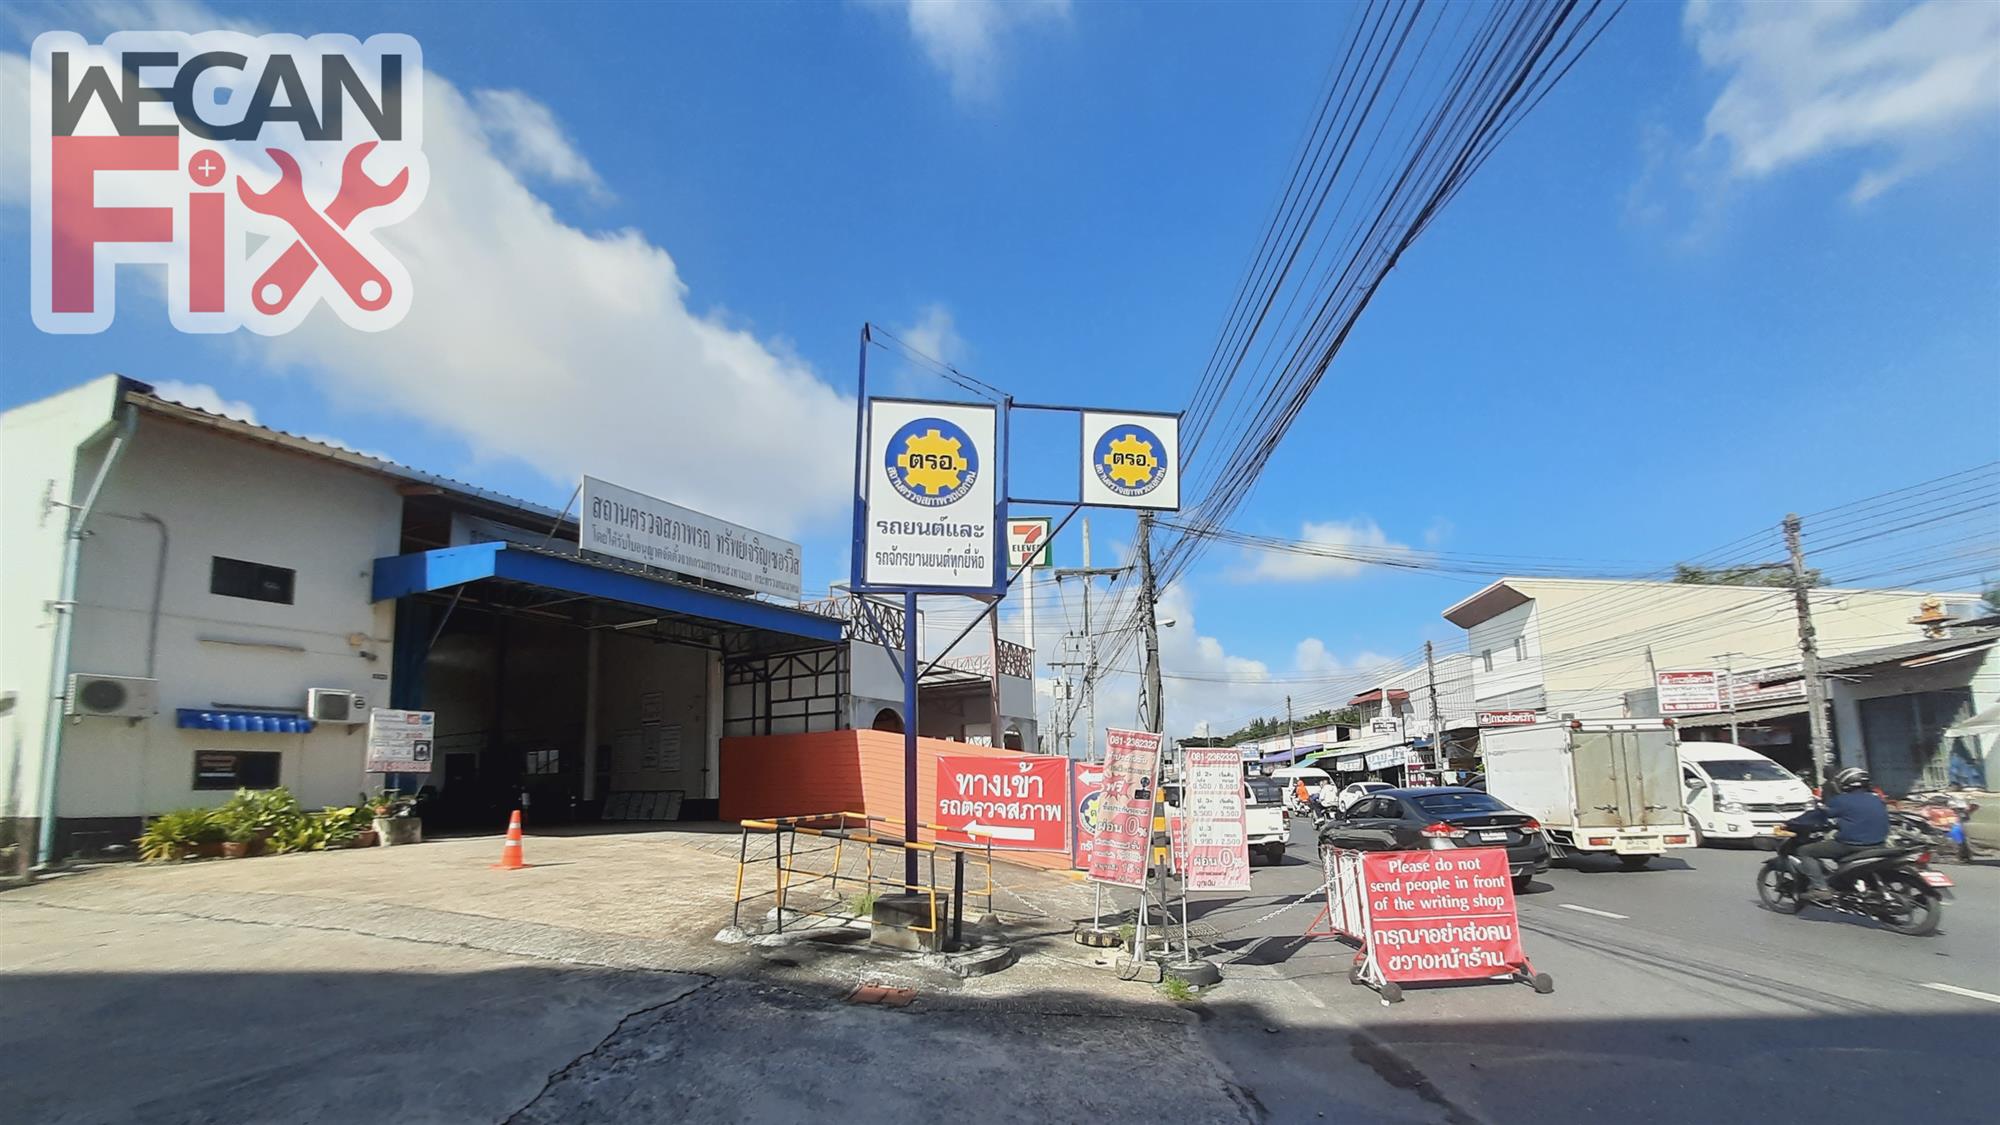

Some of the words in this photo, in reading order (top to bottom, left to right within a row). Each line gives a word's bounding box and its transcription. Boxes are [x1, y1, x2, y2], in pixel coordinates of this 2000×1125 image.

[909, 453, 957, 471] ตรอ.
[1112, 452, 1151, 467] ตรอ.
[592, 496, 711, 550] สถานตรวจสภาพรถ
[876, 515, 985, 538] รถยนต์และ
[875, 543, 985, 576] รถจักรยานยนต์ทุกยี่ห้อ
[955, 761, 1044, 798] ทางเข้า
[939, 799, 1062, 822] รถตรวจสภาพ
[1388, 859, 1430, 874] Please
[1434, 857, 1453, 871] do
[1457, 858, 1481, 871] not
[1370, 879, 1400, 893] send
[1405, 877, 1450, 895] people
[1455, 876, 1469, 889] in
[1473, 874, 1506, 889] front
[1374, 897, 1389, 911] of
[1393, 897, 1415, 910] the
[1419, 894, 1470, 911] writing
[1472, 893, 1505, 910] shop
[1373, 921, 1512, 950] กรุณาอย่าส่งคน
[1388, 947, 1505, 971] ขวางหน้าร้าน
